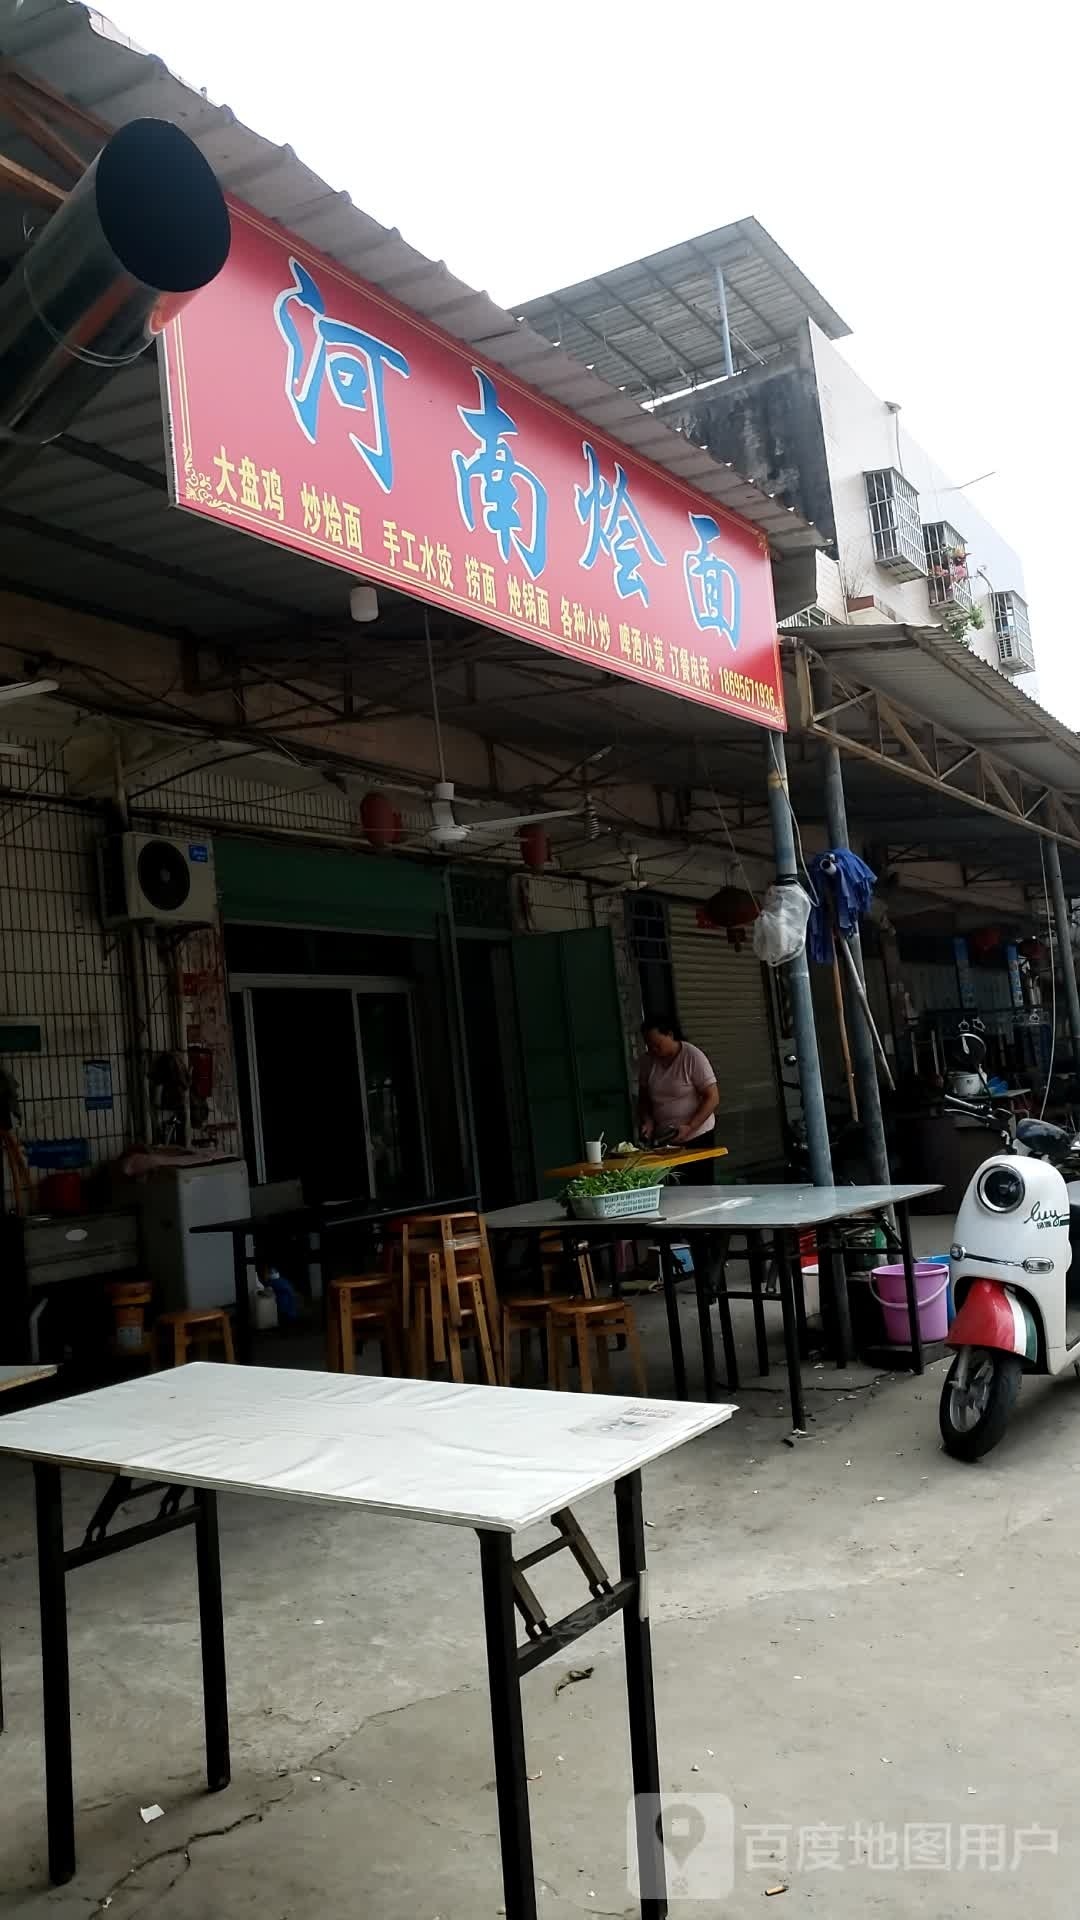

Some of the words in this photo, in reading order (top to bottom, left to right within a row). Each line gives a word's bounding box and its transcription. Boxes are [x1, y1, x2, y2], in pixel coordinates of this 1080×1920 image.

[213, 444, 285, 521] 大盘鸡
[300, 481, 363, 554] 炒烩面
[383, 519, 455, 590] 手工水饺
[465, 554, 497, 608] 捞面
[560, 596, 611, 651] 各种小炒
[619, 623, 665, 673] 啤酒小菜
[718, 666, 775, 711] 18695671936
[273, 256, 742, 650] 河南烩面
